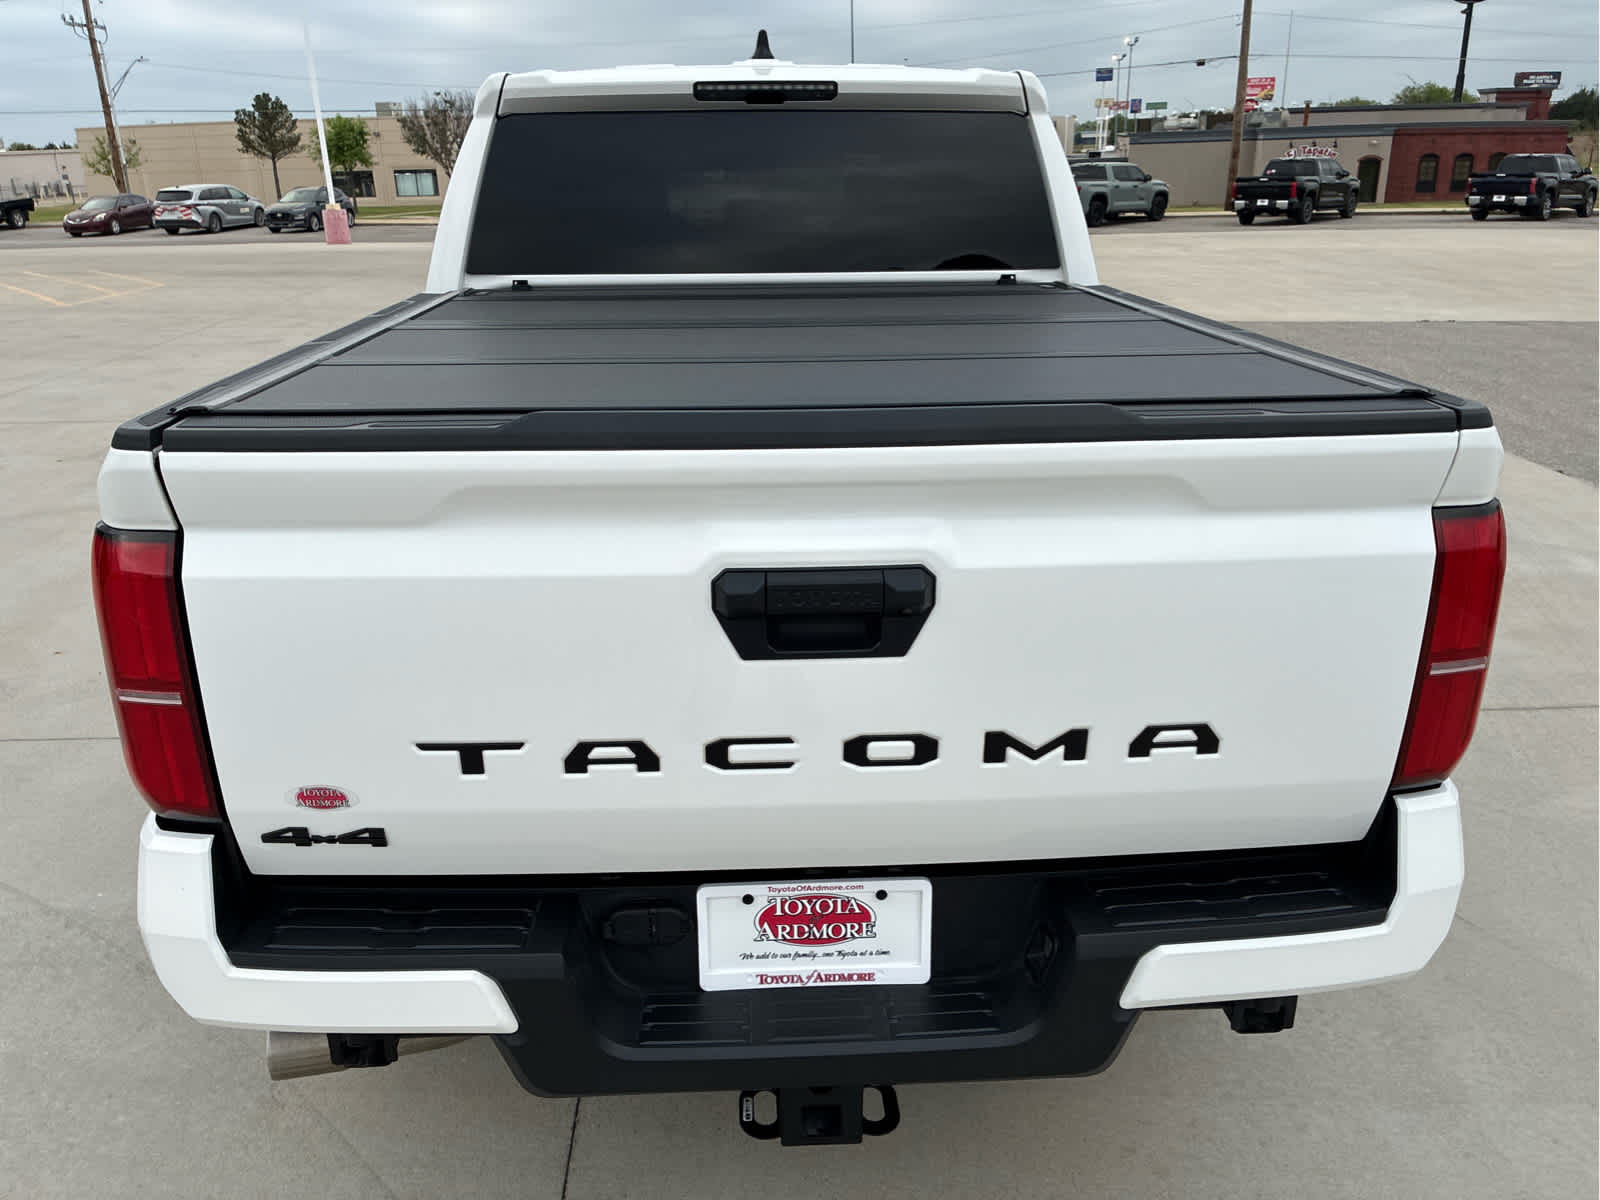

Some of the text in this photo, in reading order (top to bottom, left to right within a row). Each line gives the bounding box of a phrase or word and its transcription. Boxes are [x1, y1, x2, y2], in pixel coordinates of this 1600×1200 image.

[413, 722, 1221, 775] TACOMA
[767, 884, 864, 894] ToyotaOfArdmore.com
[768, 896, 863, 916] TOYOTA
[753, 921, 877, 941] ARDMORE
[756, 973, 804, 985] TOYOTA
[813, 970, 876, 984] ARDMORE
